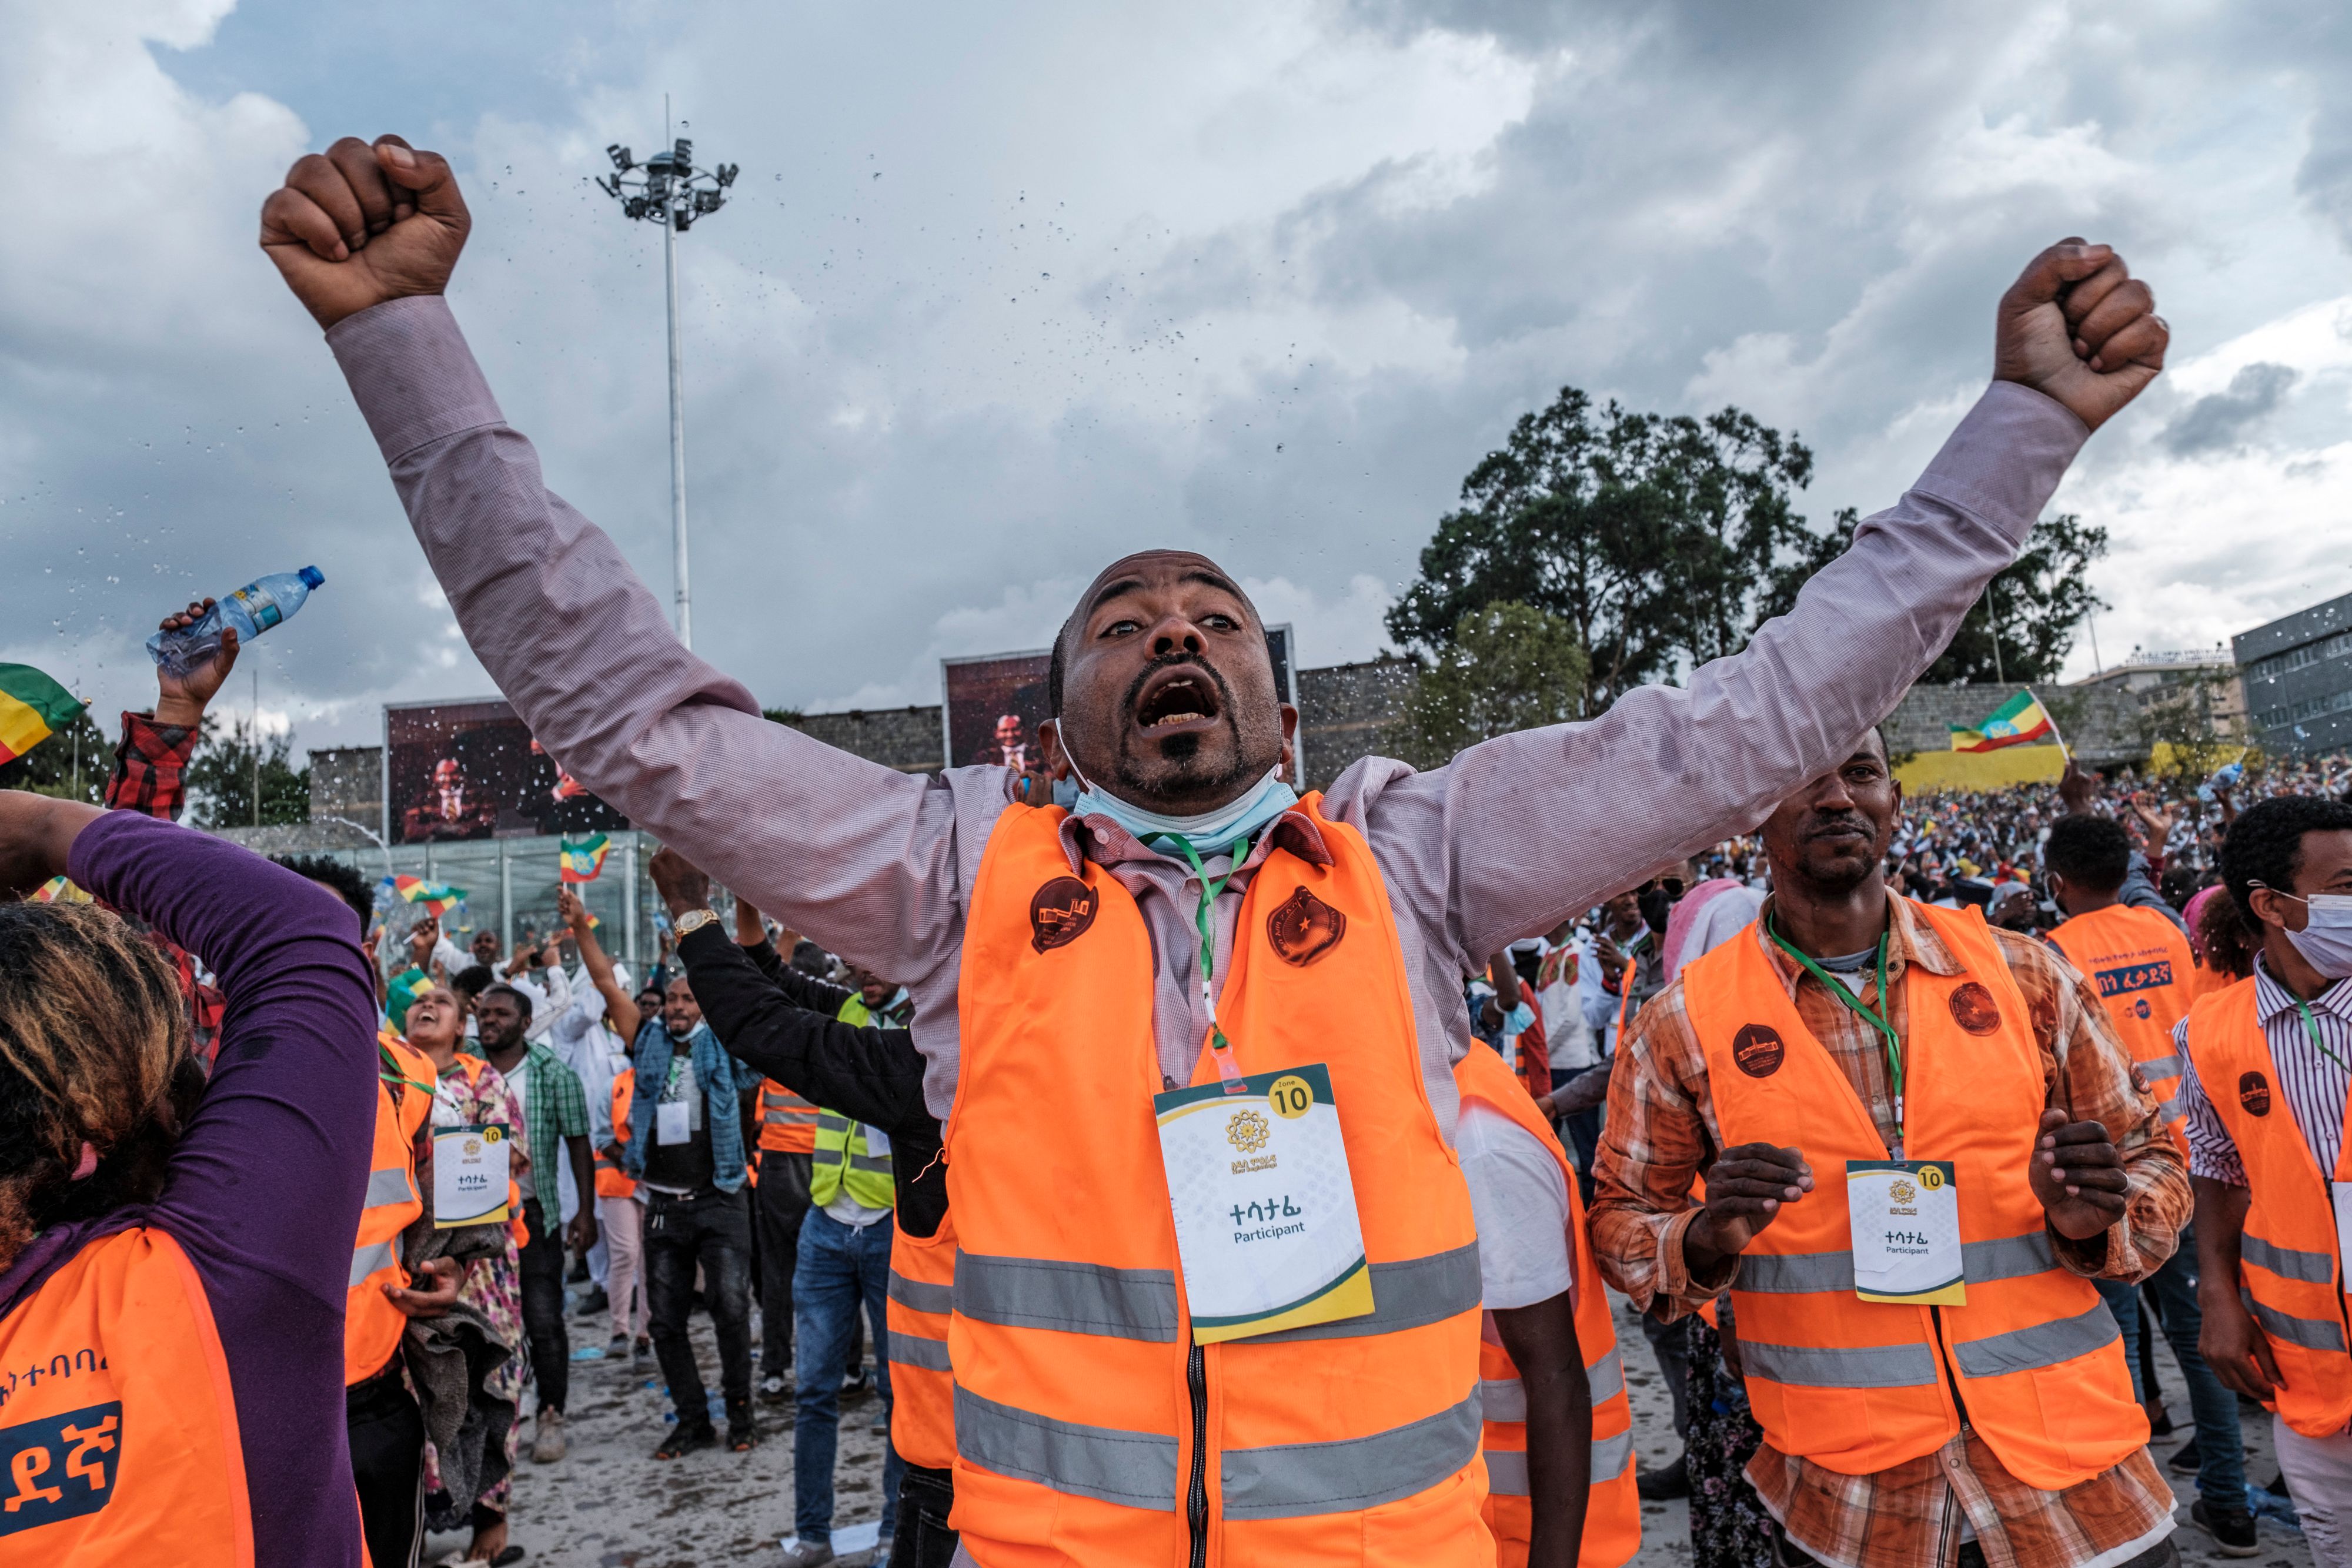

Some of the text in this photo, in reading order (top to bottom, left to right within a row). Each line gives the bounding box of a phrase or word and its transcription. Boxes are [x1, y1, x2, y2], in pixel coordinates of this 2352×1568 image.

[1274, 1087, 1307, 1114] 10
[485, 1131, 499, 1142] 10
[1920, 1172, 1940, 1186] 10
[1230, 1195, 1301, 1226] ተሳታፊ
[1234, 1222, 1305, 1243] Participant
[1885, 1231, 1928, 1245] ተሳታፊ
[1886, 1246, 1929, 1255] Participant
